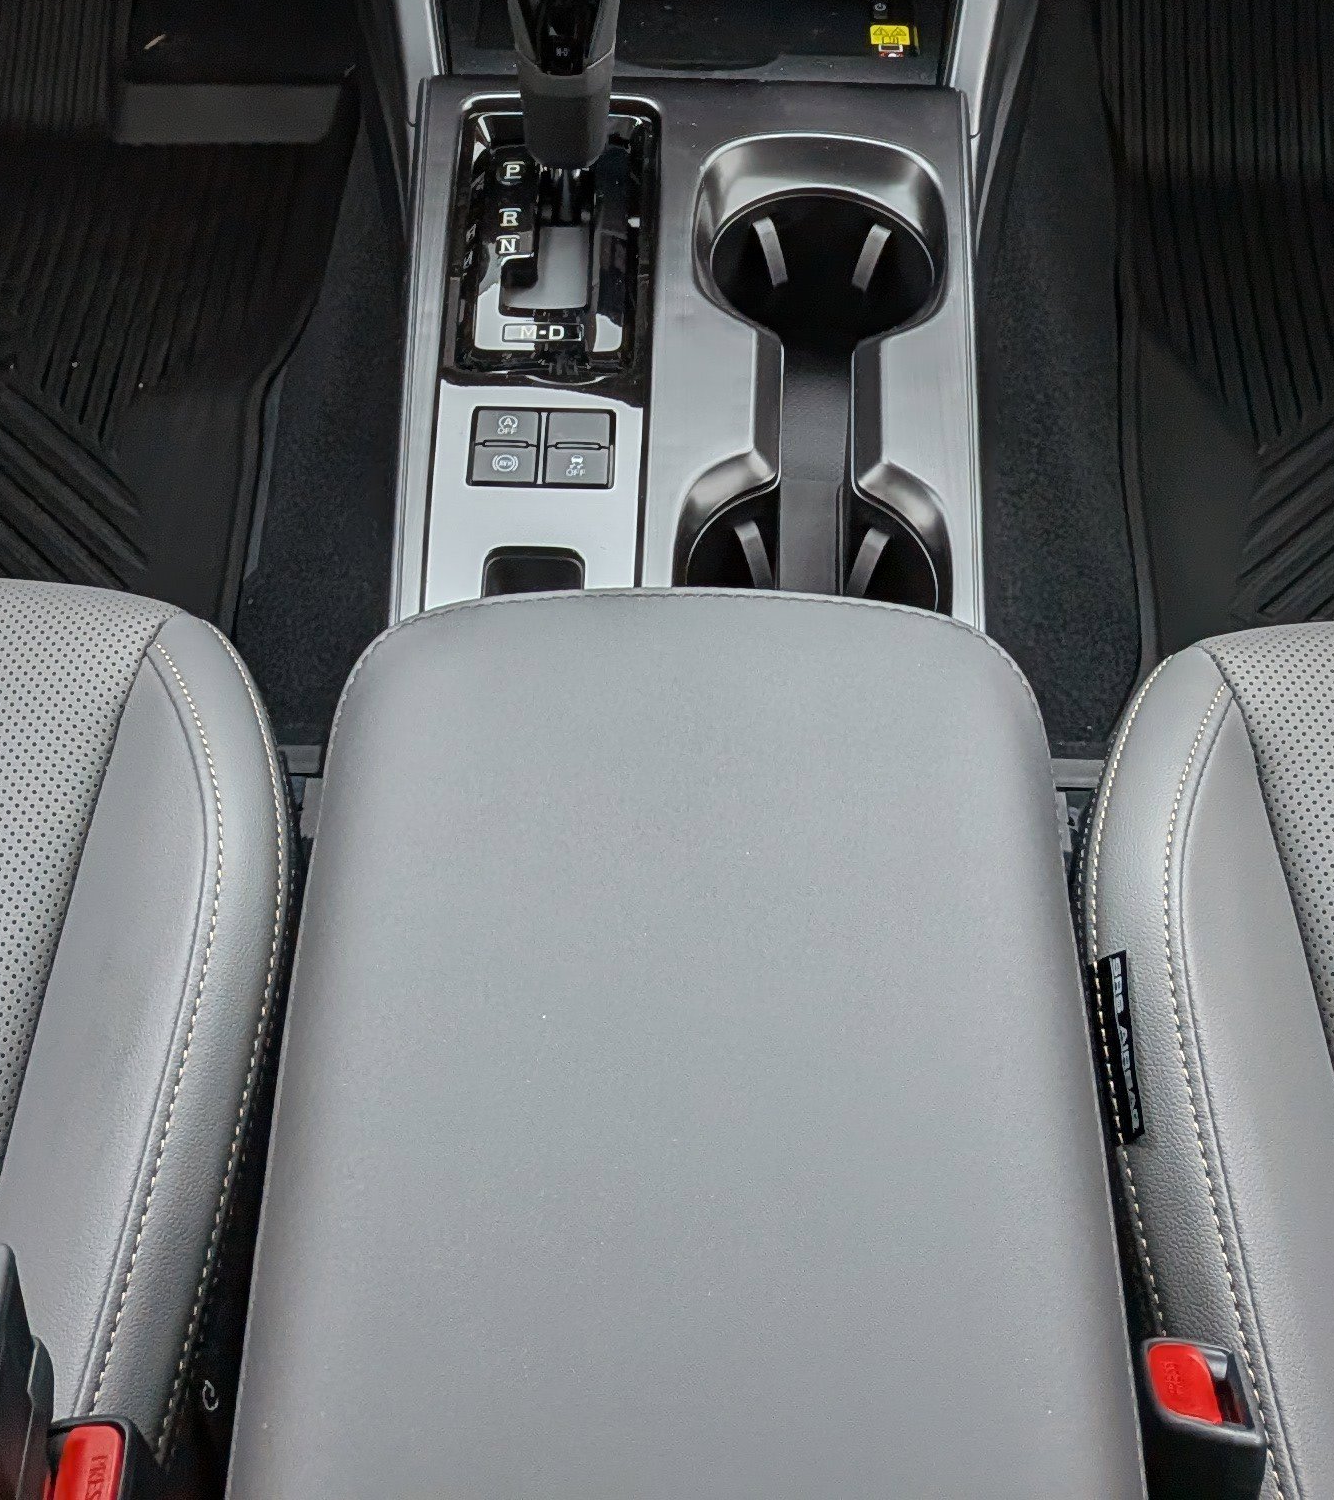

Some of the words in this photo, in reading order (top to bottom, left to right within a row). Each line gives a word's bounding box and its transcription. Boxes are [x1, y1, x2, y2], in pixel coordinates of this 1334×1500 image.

[502, 211, 518, 225] R
[500, 238, 517, 252] N
[497, 427, 518, 435] OFF
[566, 469, 586, 477] OFF
